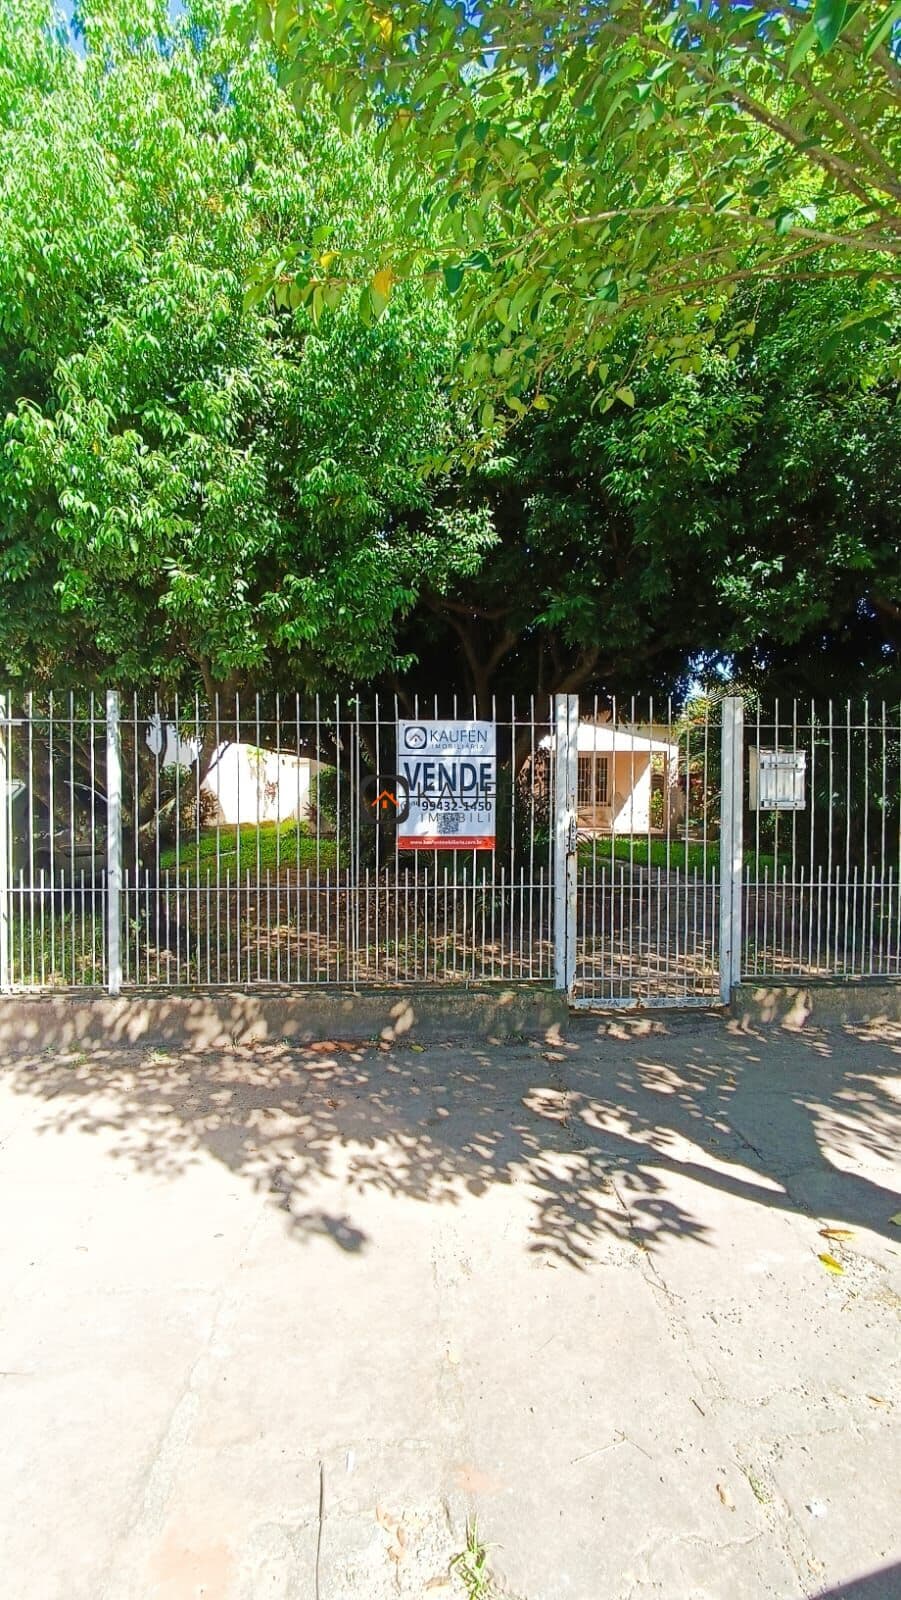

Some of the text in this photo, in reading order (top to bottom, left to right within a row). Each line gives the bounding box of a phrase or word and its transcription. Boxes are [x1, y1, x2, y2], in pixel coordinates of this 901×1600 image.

[430, 730, 488, 742] KAUFEN
[403, 762, 492, 791] VENDE
[421, 801, 492, 812] 99432-1450
